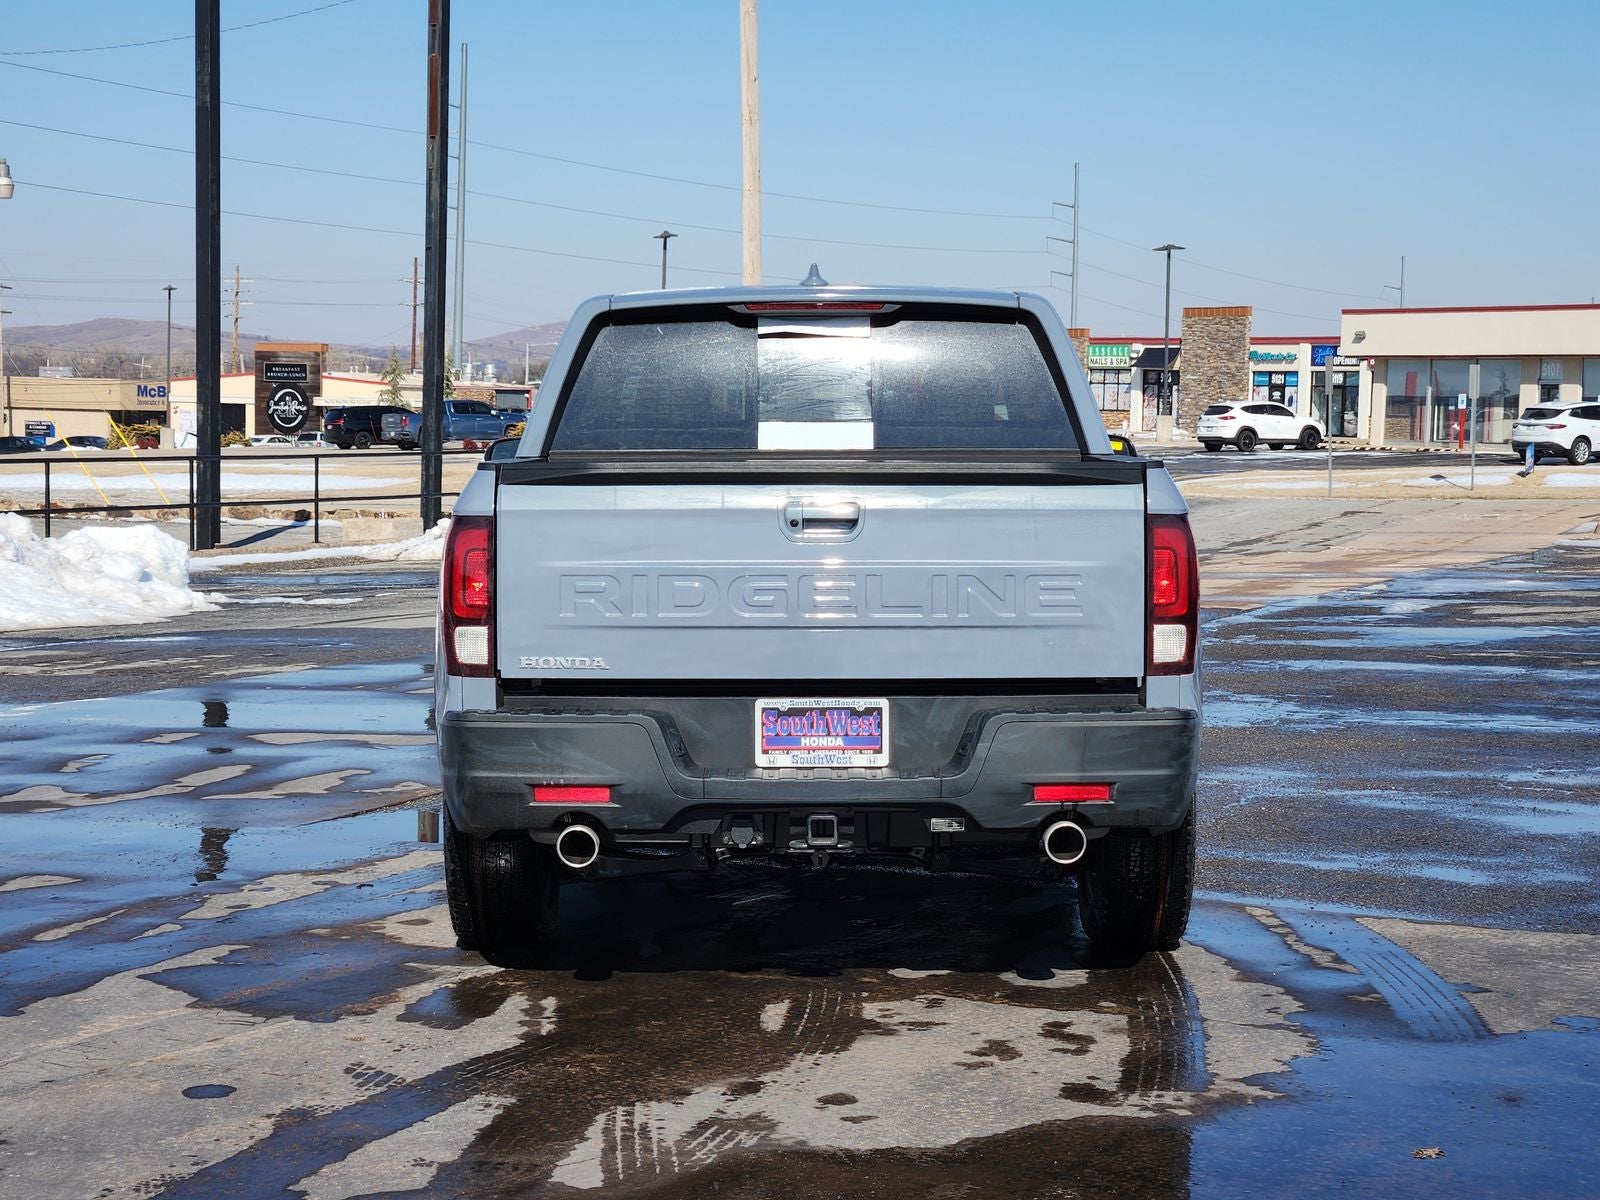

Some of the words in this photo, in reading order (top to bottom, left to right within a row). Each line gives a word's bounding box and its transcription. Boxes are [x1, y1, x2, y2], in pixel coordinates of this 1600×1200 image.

[1089, 346, 1129, 357] ESSENCE
[1090, 357, 1109, 366] NAILS
[1110, 357, 1115, 366] &
[1115, 357, 1128, 366] SPA
[1271, 373, 1285, 384] 5121
[559, 573, 1084, 619] RIDGELINE
[519, 656, 610, 670] HONDA
[800, 736, 845, 747] HONDA
